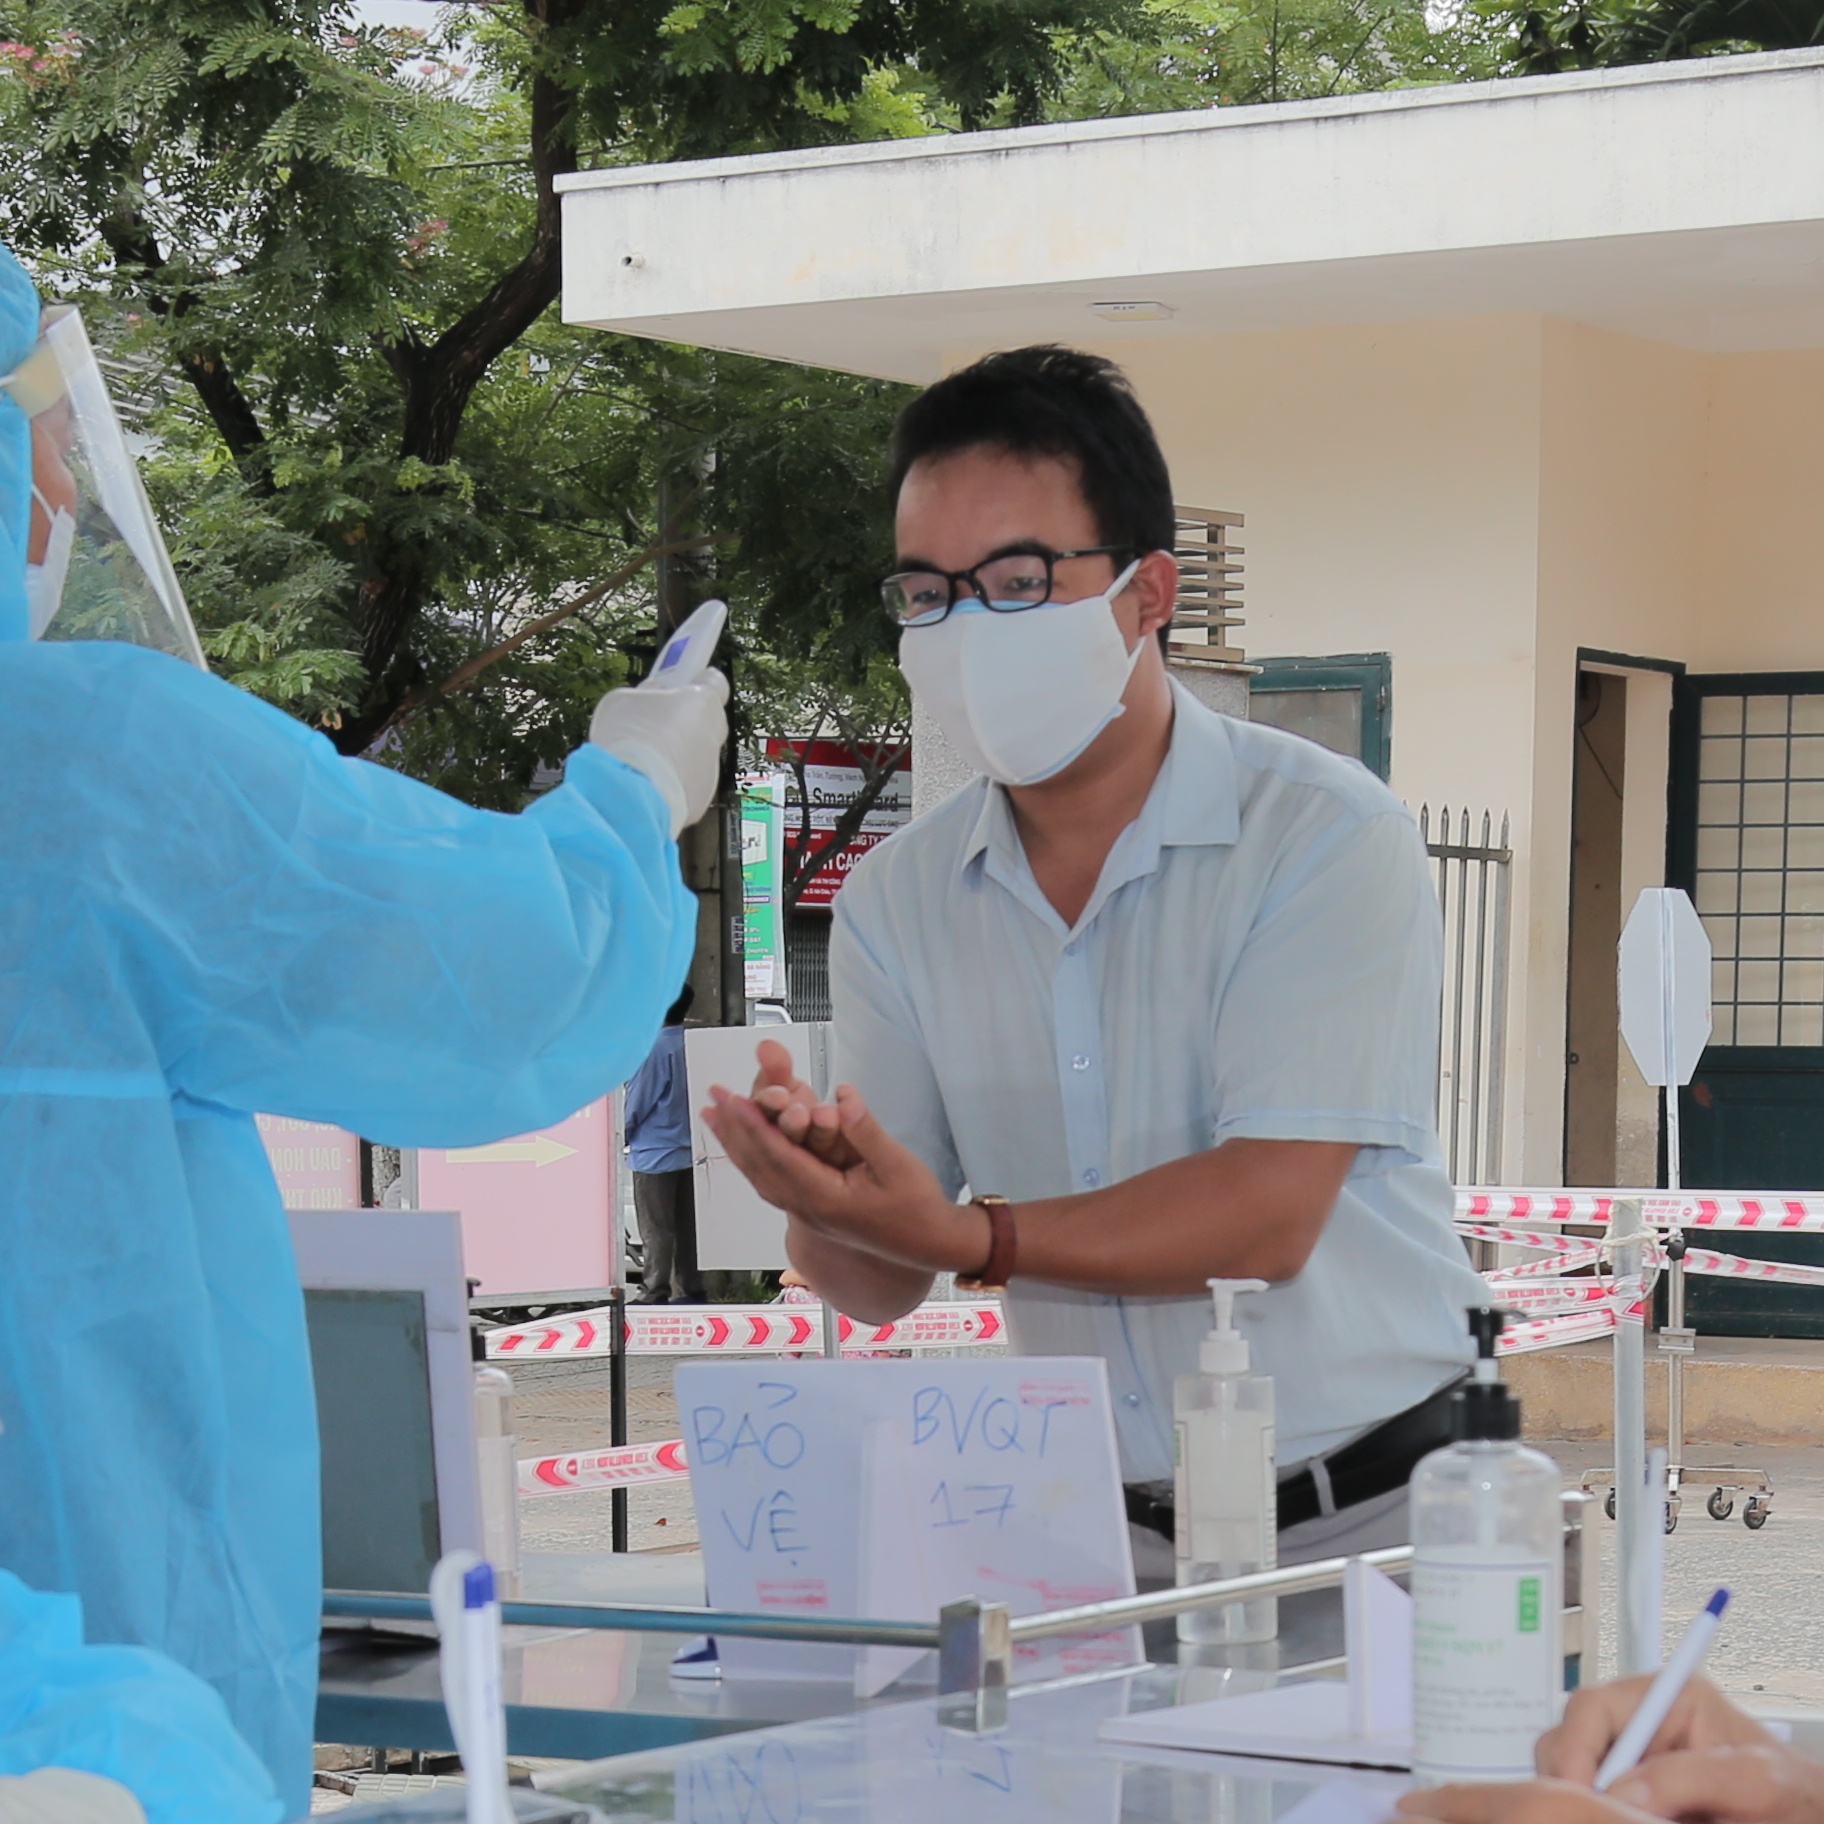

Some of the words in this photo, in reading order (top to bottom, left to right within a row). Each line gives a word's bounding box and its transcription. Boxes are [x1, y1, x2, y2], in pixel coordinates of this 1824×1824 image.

[693, 1382, 805, 1469] BẢO
[913, 1386, 1068, 1458] BVQT
[721, 1489, 809, 1567] VỆ
[931, 1481, 1016, 1528] 17
